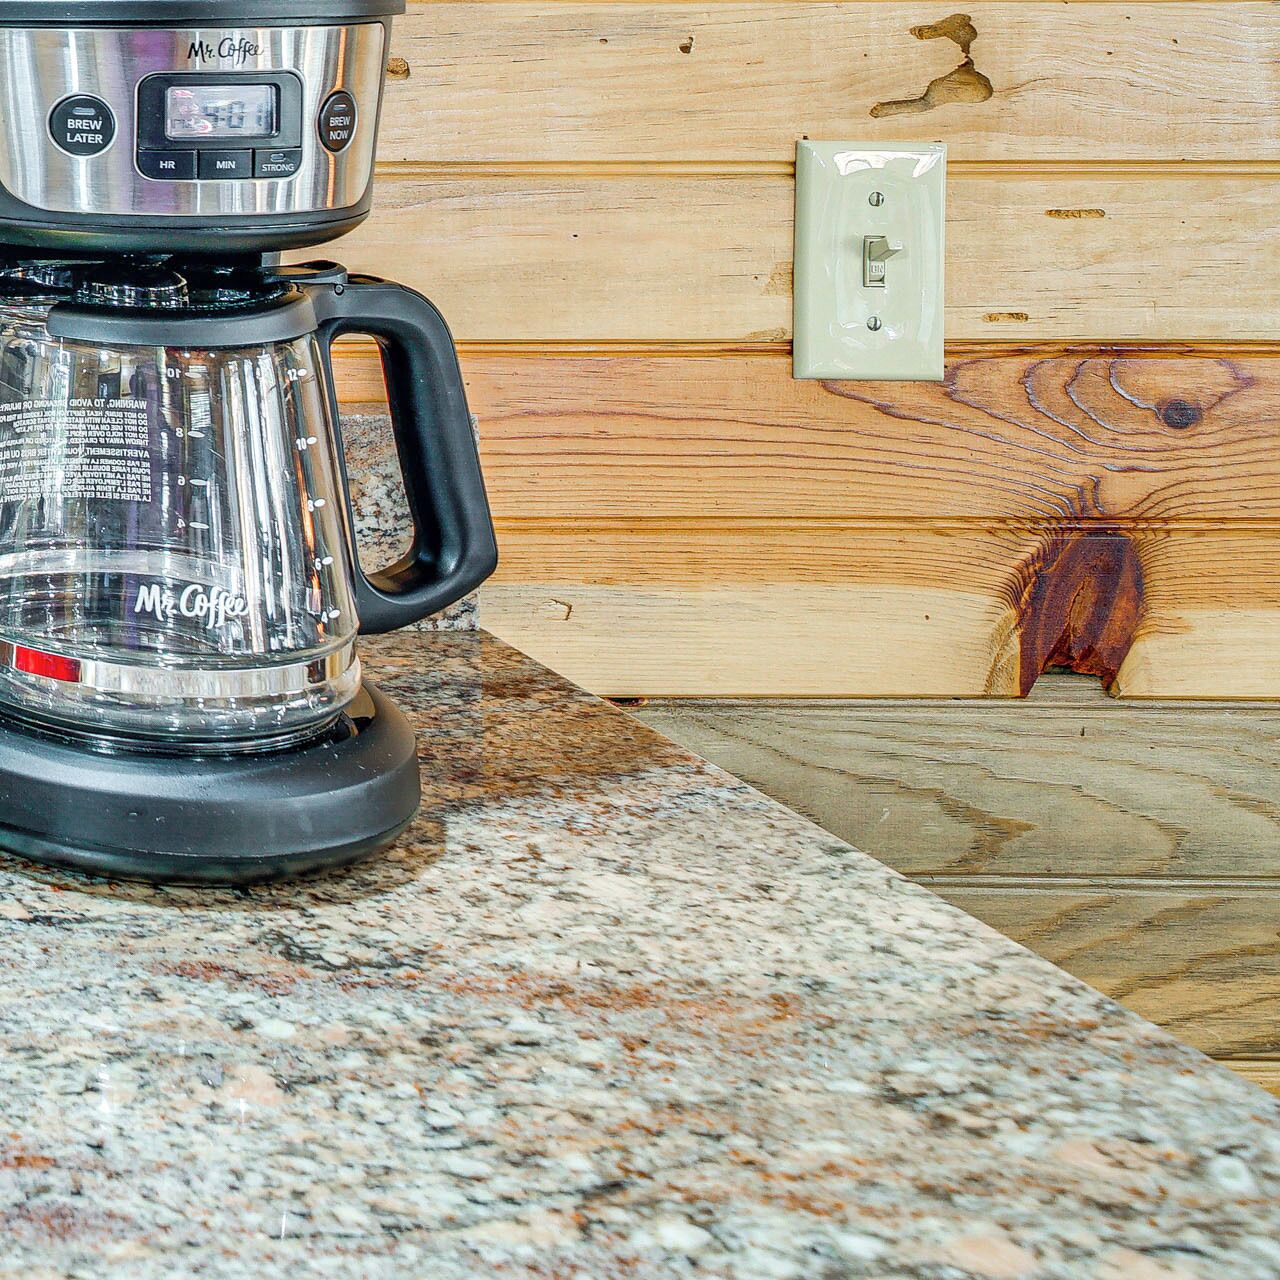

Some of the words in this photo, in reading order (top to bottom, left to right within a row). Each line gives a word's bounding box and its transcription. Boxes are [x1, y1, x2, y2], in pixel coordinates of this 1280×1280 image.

[187, 40, 215, 63] Mr.
[218, 37, 264, 65] Coffee
[67, 119, 102, 130] BREW
[329, 116, 351, 127] BREW
[66, 132, 103, 144] LATER
[329, 130, 349, 140] NOW
[159, 161, 175, 169] HR
[216, 161, 236, 169] MIN
[261, 164, 294, 172] STRONG
[287, 369, 298, 381] 12
[295, 437, 307, 451] 10
[314, 556, 322, 570] 6
[180, 584, 249, 629] Coffee
[321, 610, 329, 624] 4
